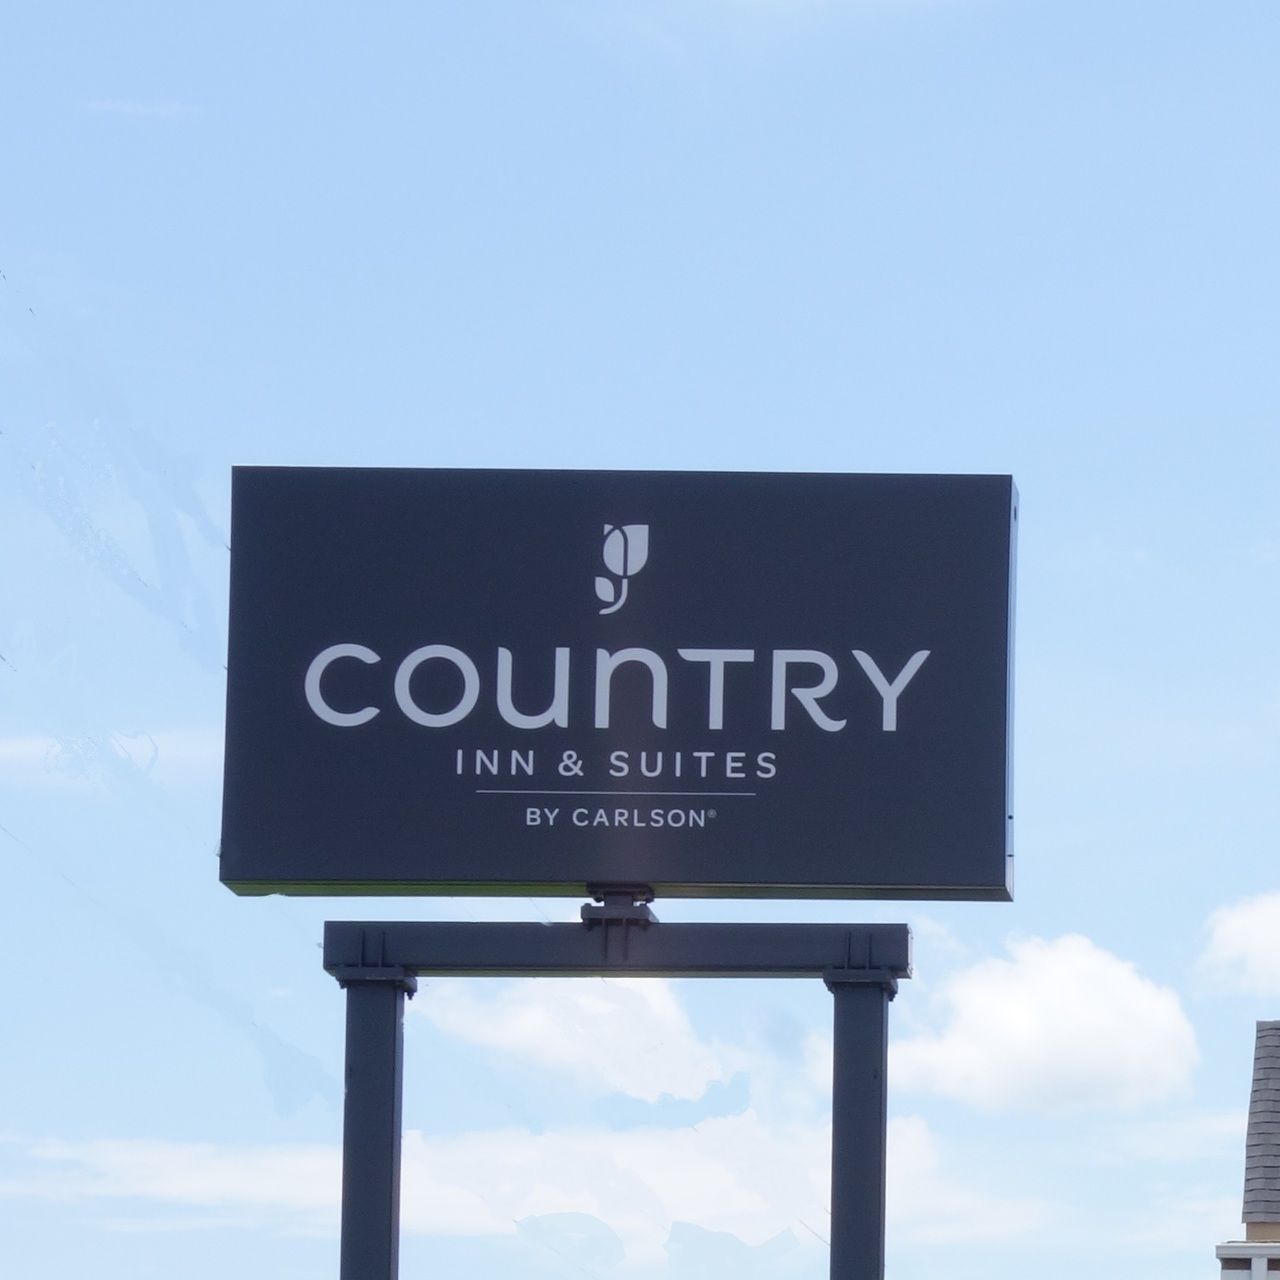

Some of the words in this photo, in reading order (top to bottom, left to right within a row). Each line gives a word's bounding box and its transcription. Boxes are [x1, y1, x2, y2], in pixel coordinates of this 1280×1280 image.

[456, 749, 534, 776] INN
[558, 750, 584, 777] &
[609, 750, 776, 779] SUITES
[526, 807, 560, 826] BY
